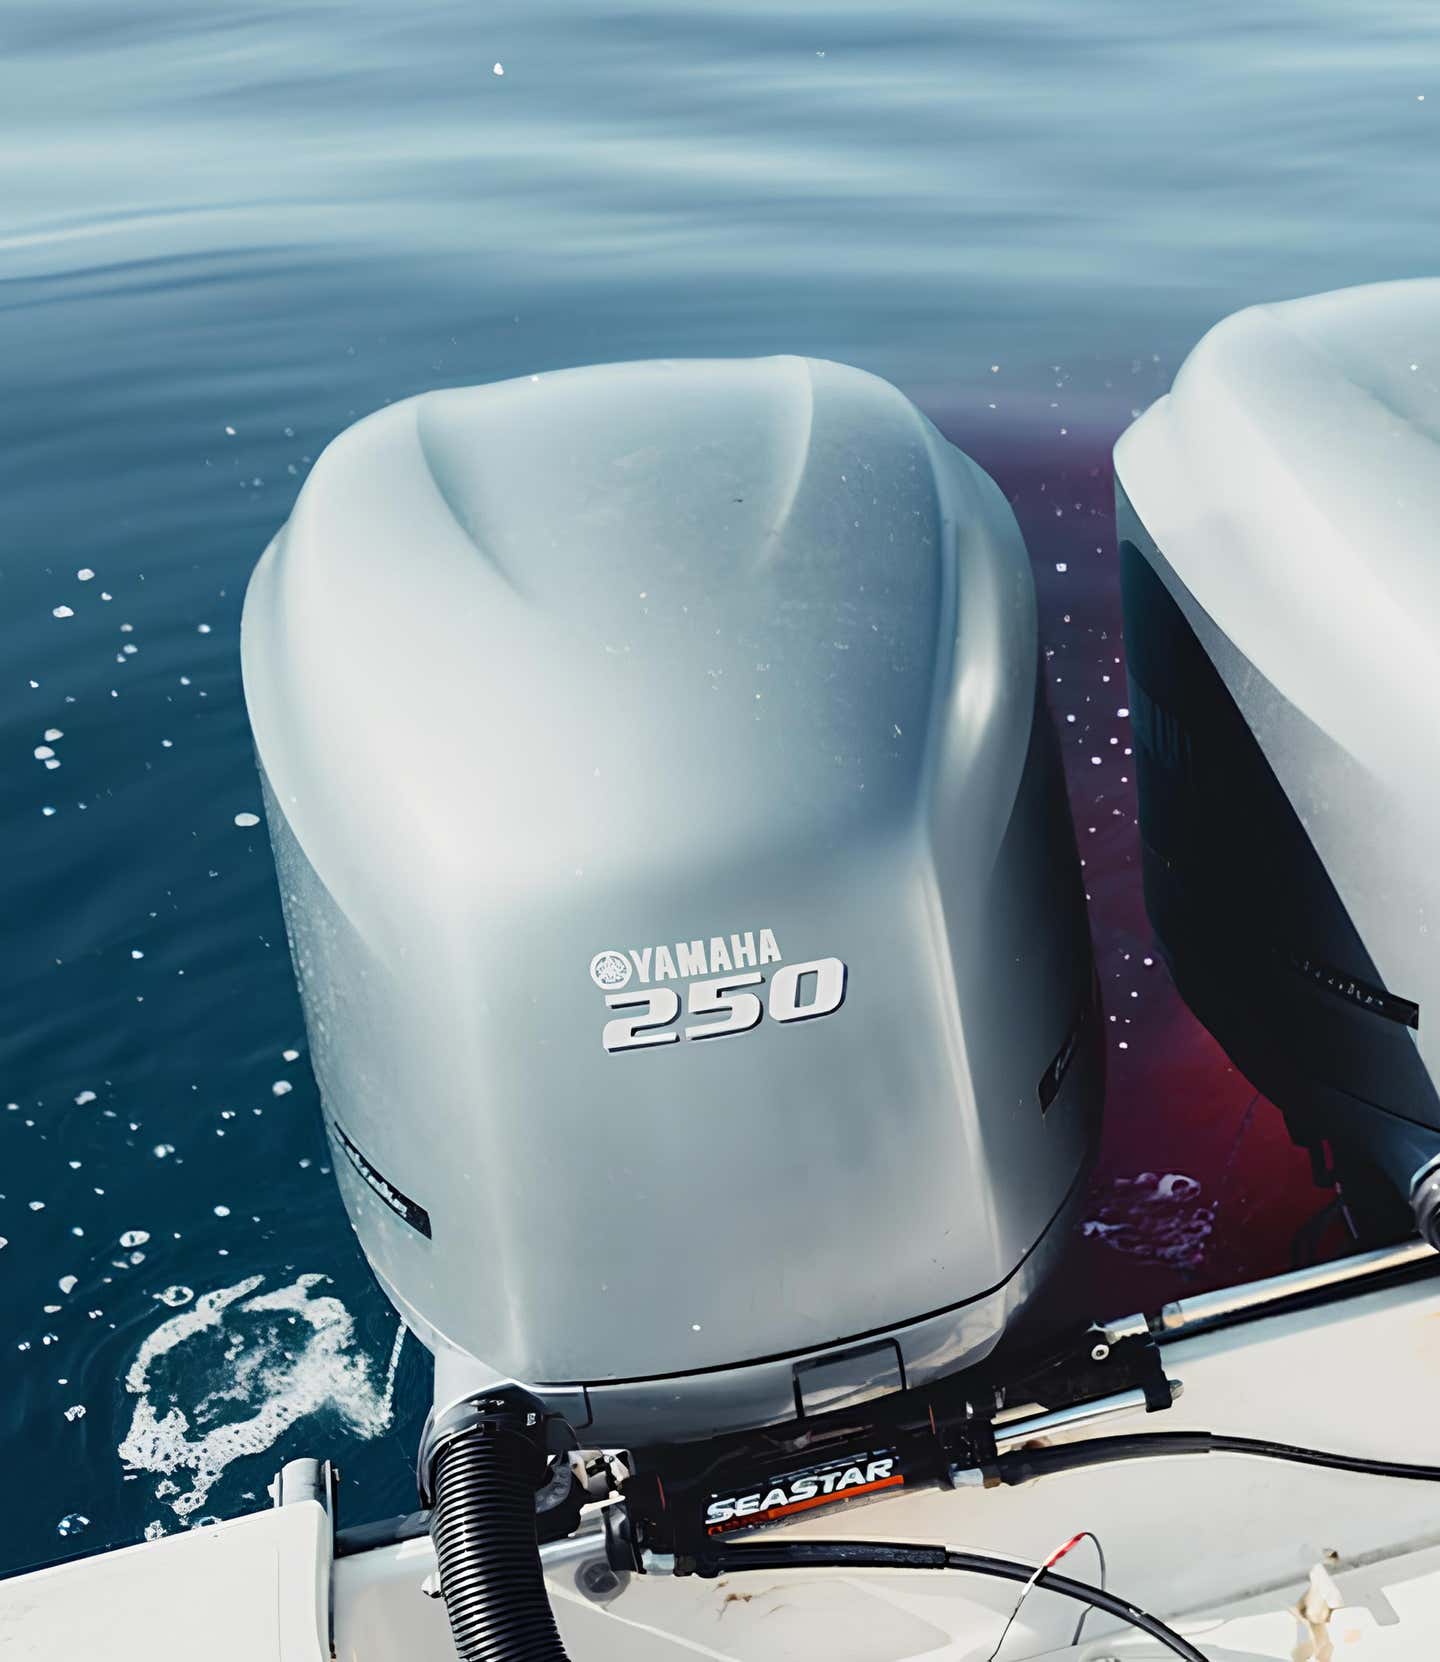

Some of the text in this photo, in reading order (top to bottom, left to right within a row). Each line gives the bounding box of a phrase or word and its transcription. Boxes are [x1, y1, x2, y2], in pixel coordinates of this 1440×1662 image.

[629, 928, 782, 983] YAMAHA
[602, 957, 848, 1053] 250
[705, 1458, 894, 1525] SEASTAR
